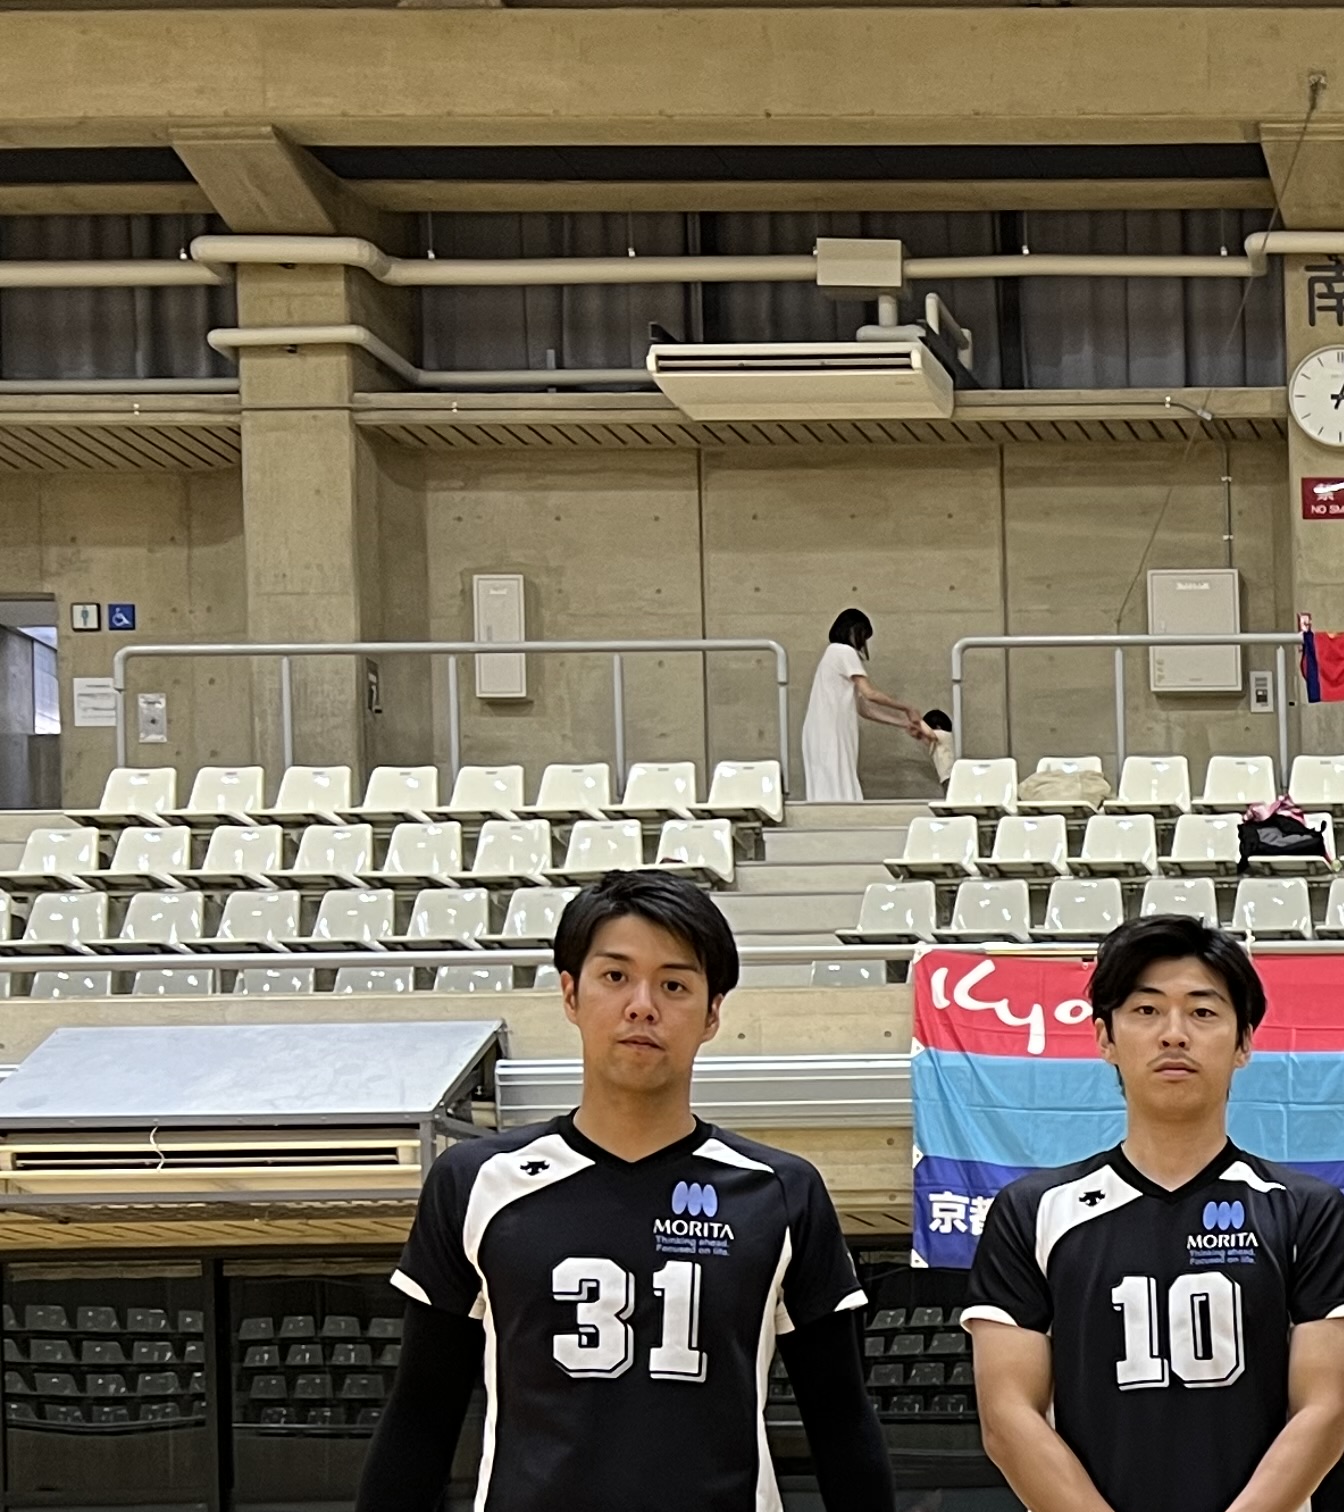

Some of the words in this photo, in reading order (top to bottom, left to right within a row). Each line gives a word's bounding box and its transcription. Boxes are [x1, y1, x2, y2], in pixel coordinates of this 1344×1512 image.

[1311, 504, 1327, 514] NO
[653, 1217, 735, 1240] MORITA
[1187, 1232, 1259, 1250] MORITA
[552, 1257, 707, 1383] 31
[1111, 1271, 1245, 1391] 10
